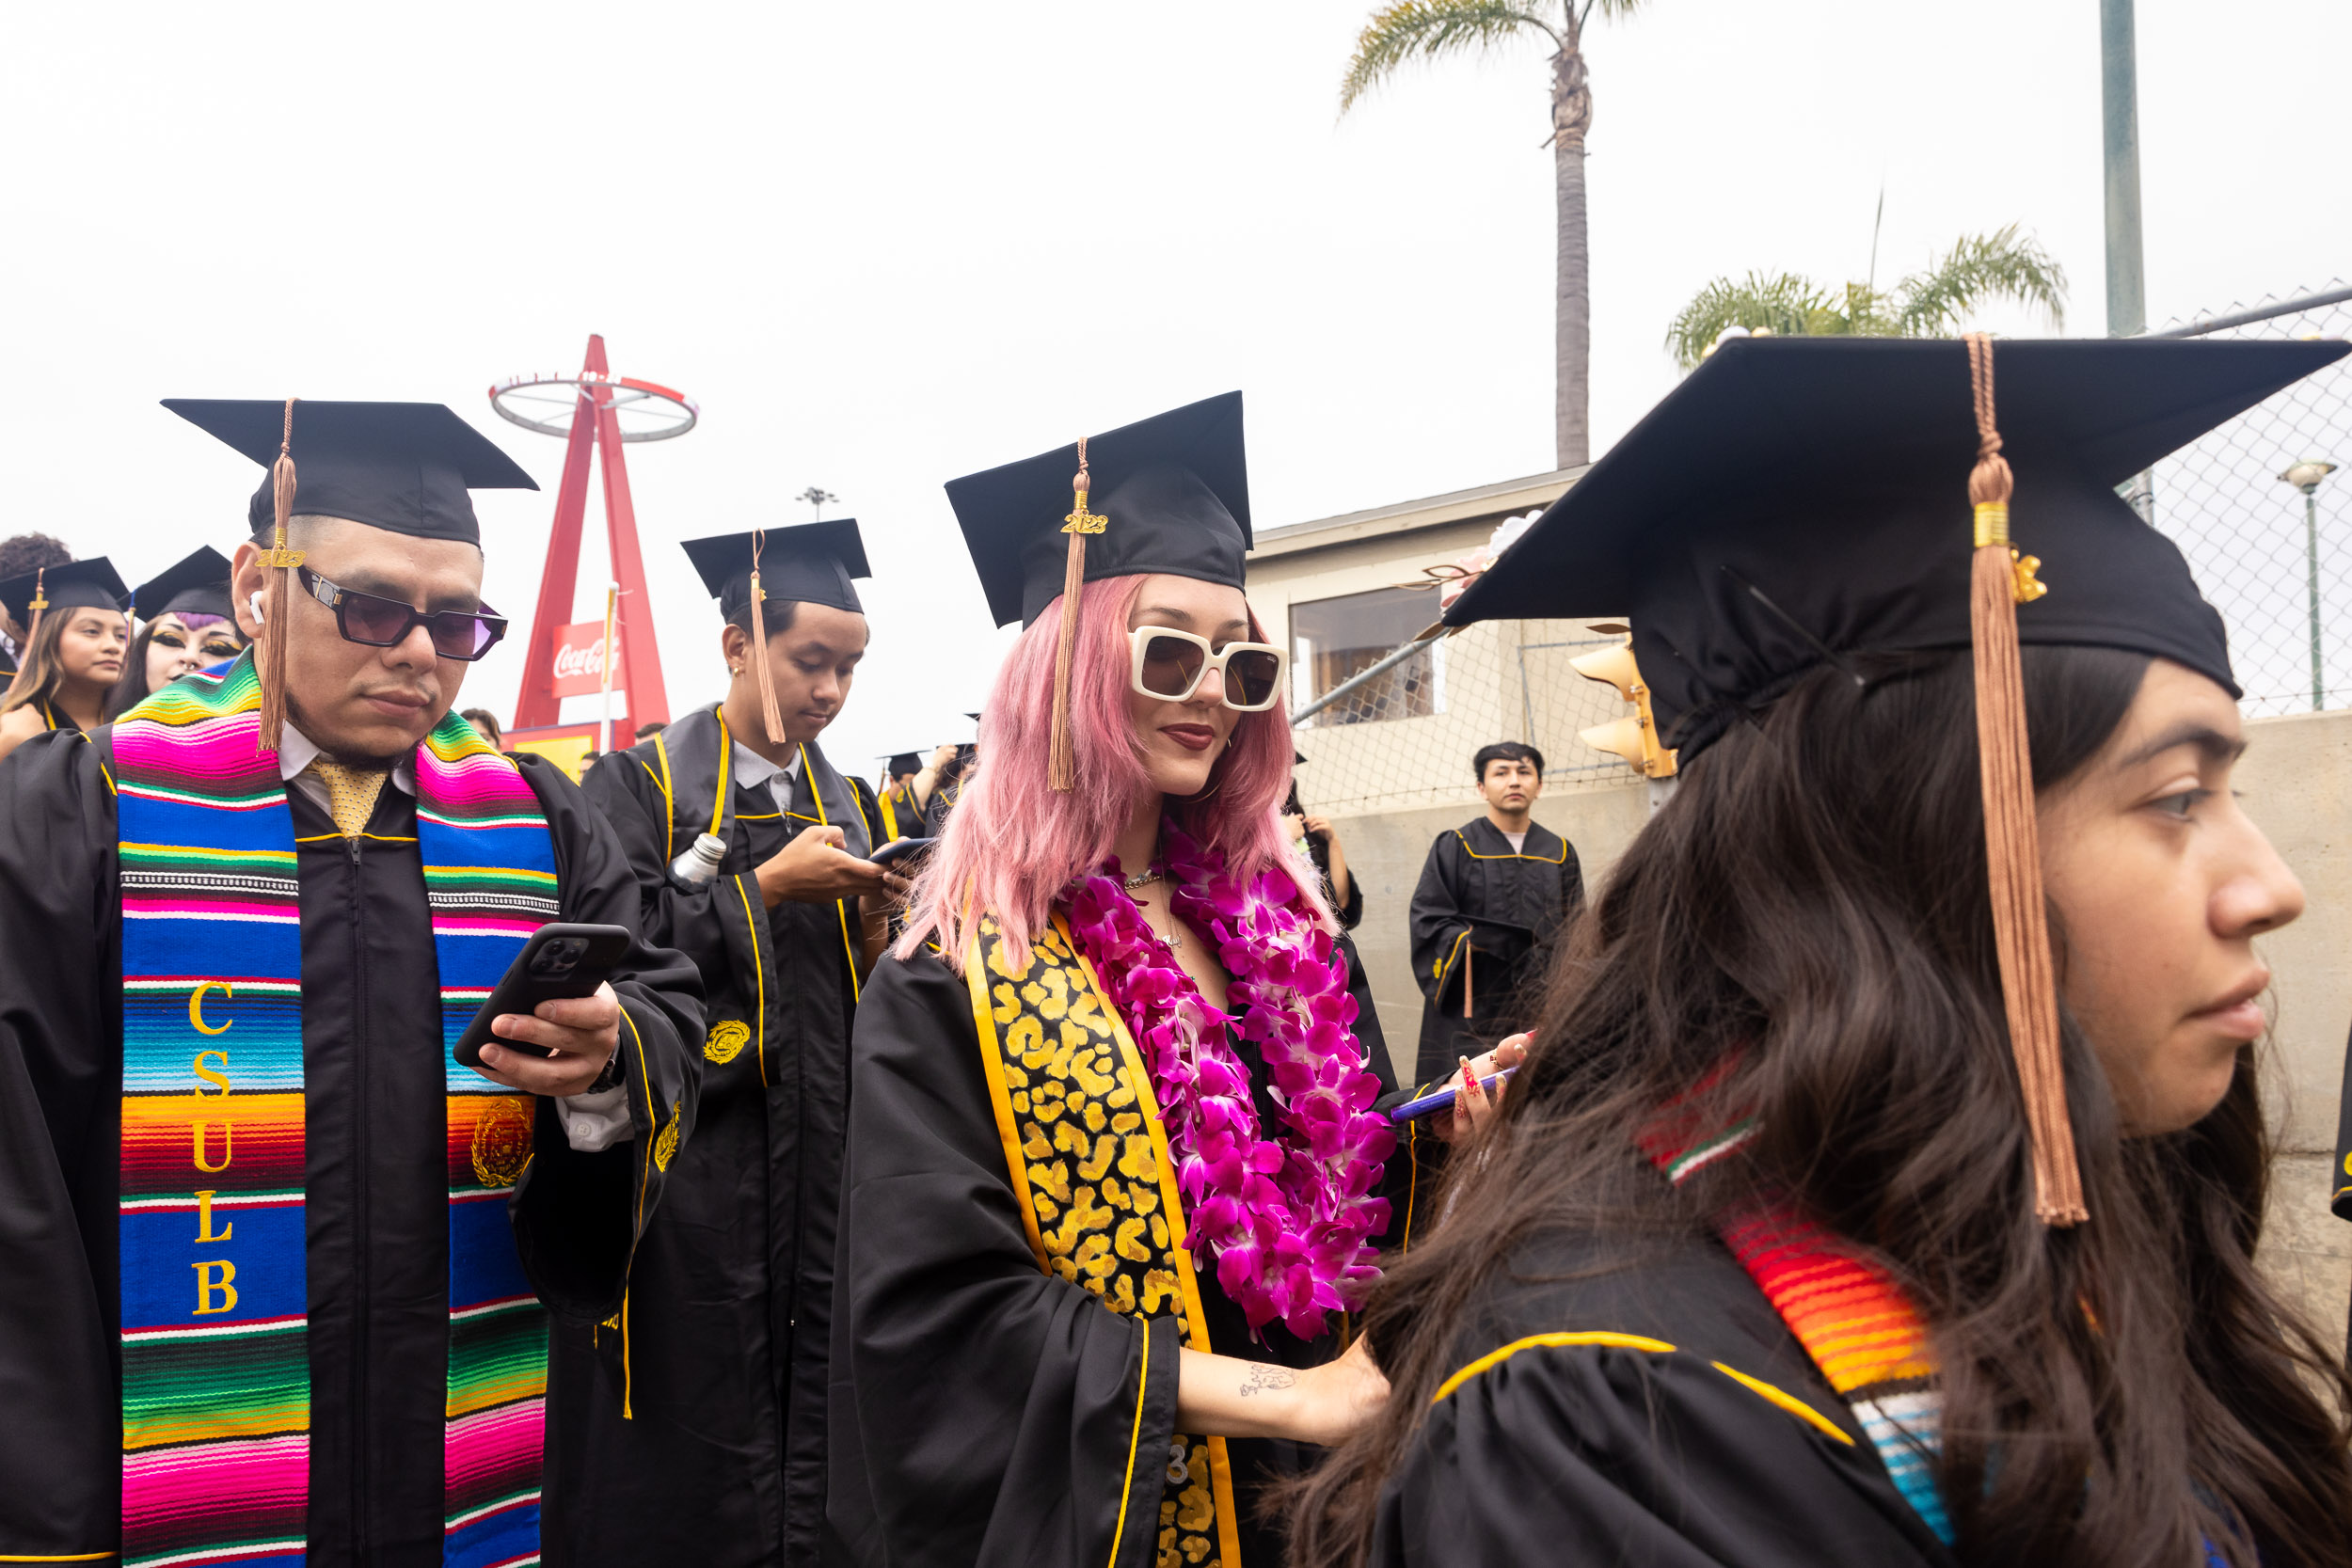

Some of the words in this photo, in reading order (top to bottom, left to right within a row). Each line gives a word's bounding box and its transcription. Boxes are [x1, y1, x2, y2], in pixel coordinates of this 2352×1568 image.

[1060, 515, 1108, 533] 2023
[255, 549, 307, 567] 2023
[189, 982, 238, 1315] CSULB
